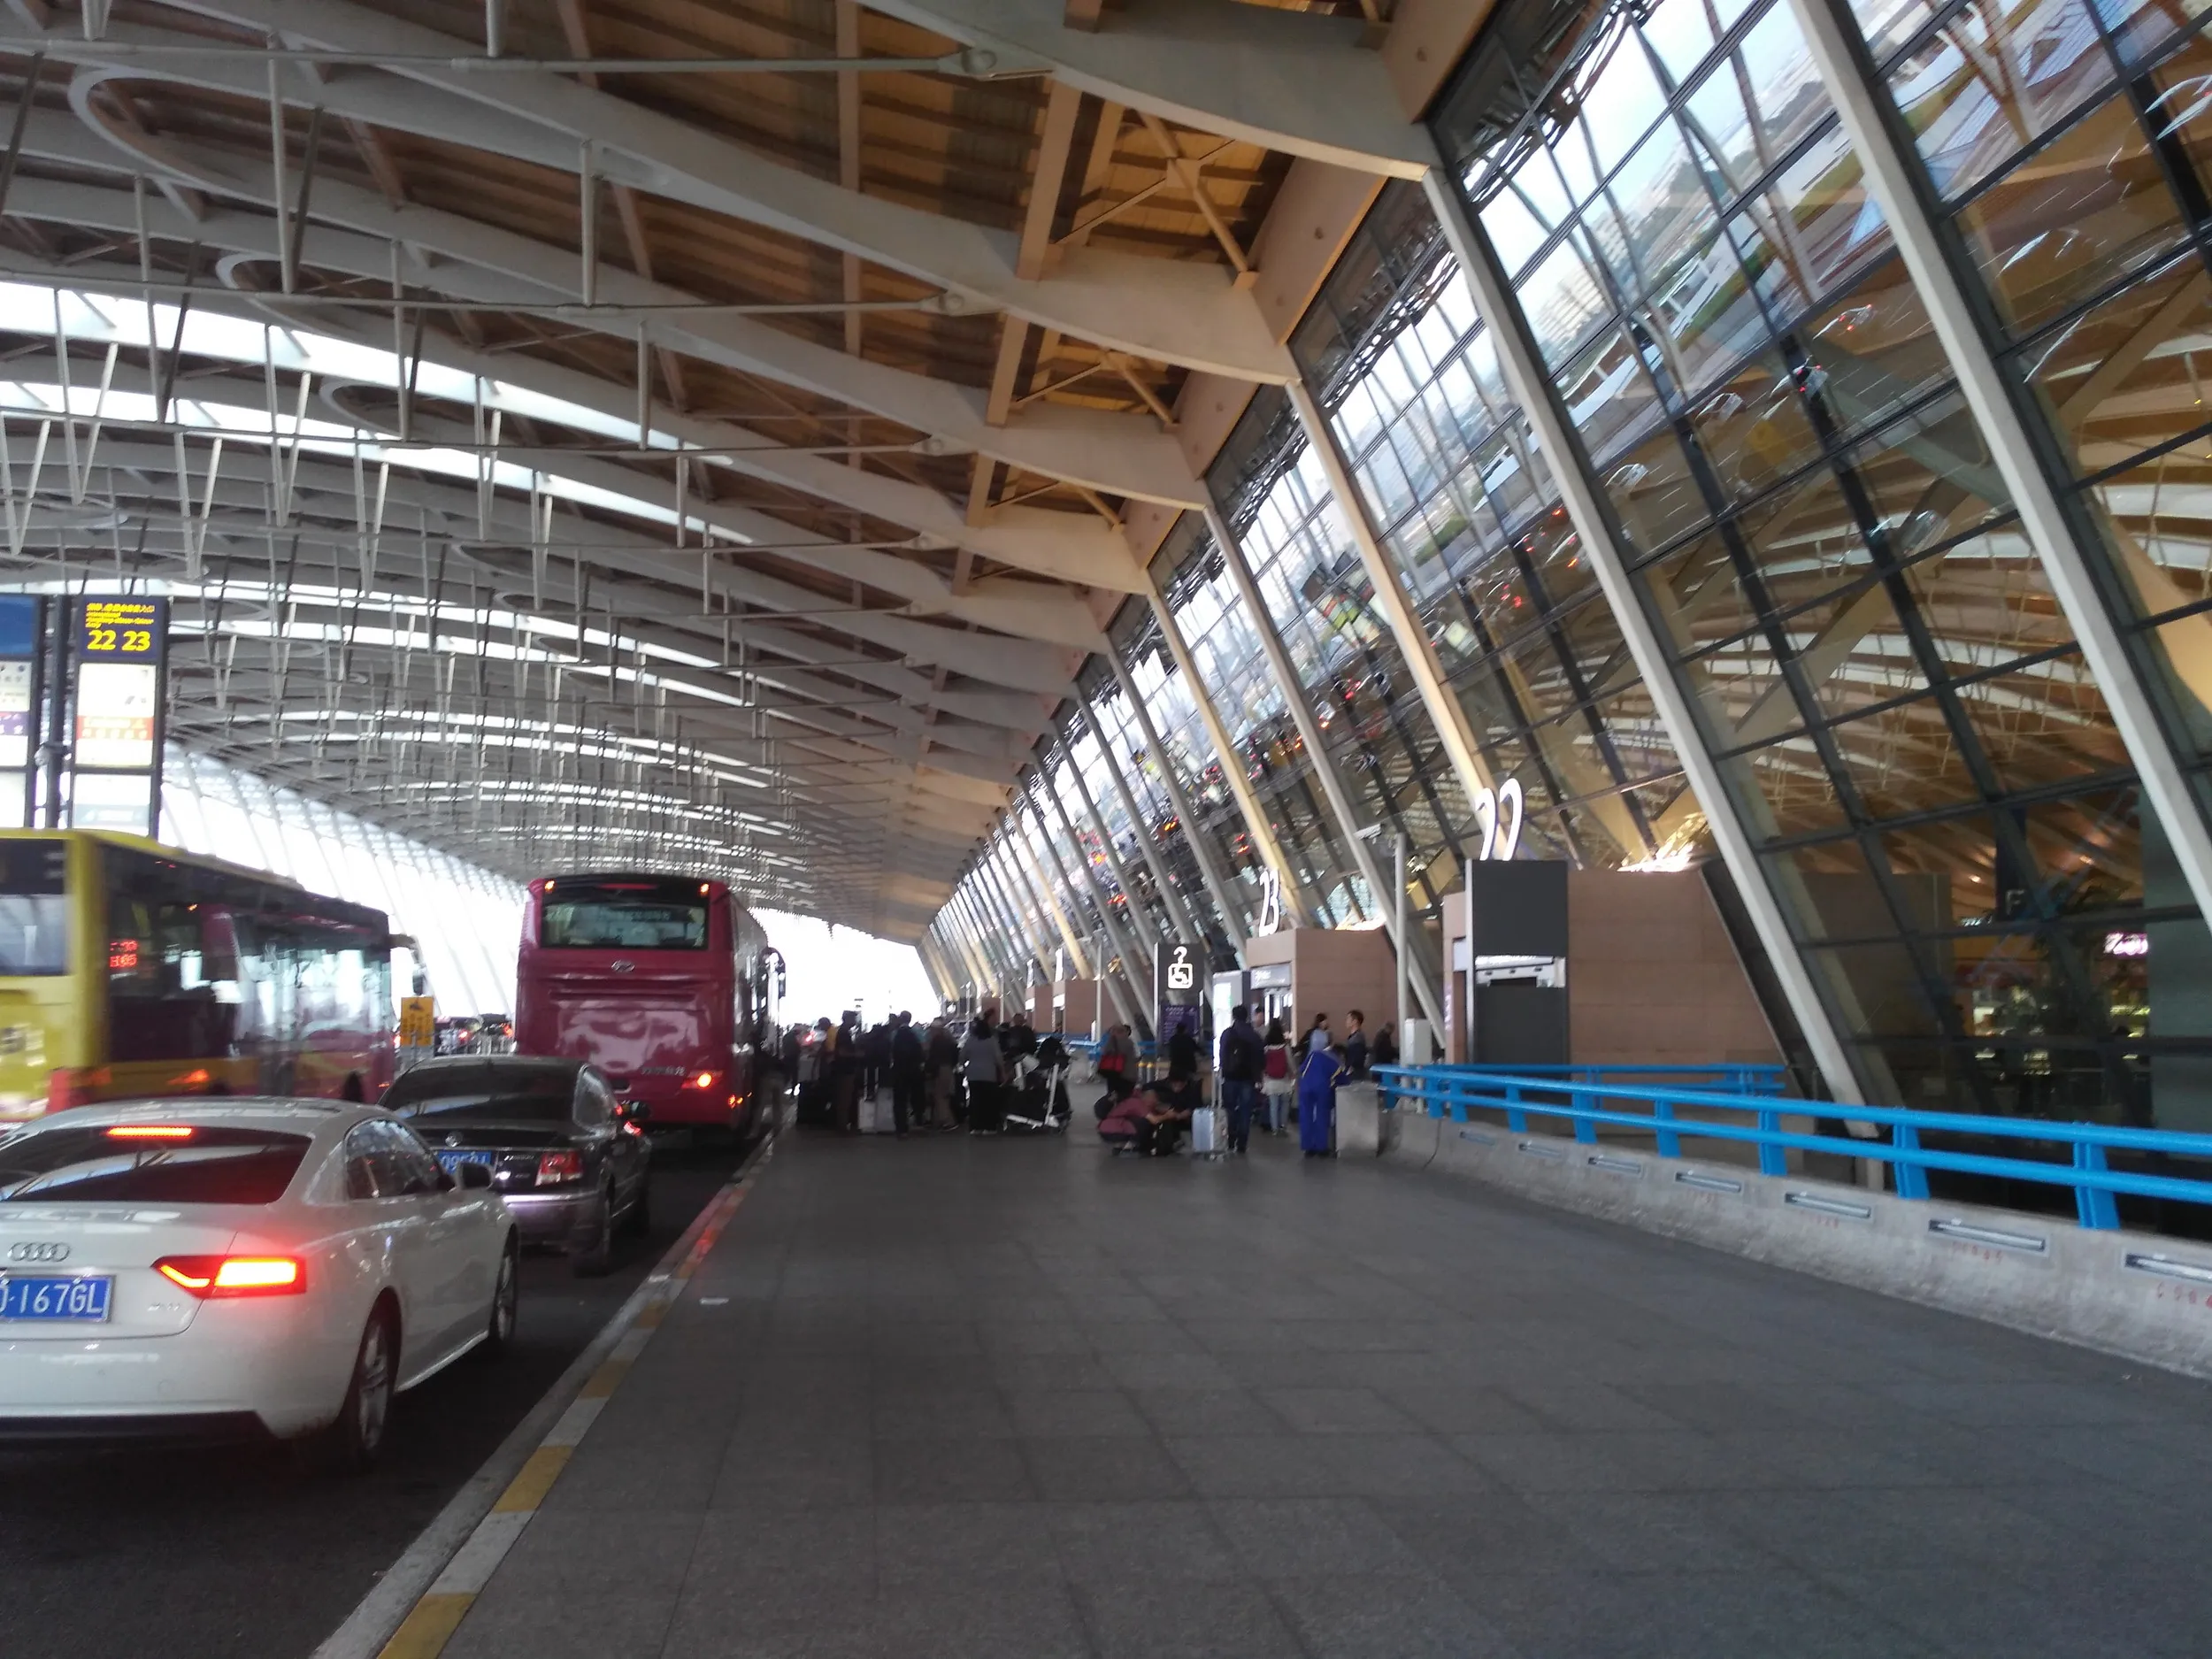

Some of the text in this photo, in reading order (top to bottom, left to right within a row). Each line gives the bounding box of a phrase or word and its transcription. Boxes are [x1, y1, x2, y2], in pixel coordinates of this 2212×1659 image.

[87, 629, 151, 652] 22 23
[1258, 868, 1280, 938] 23
[2005, 888, 2025, 915] F
